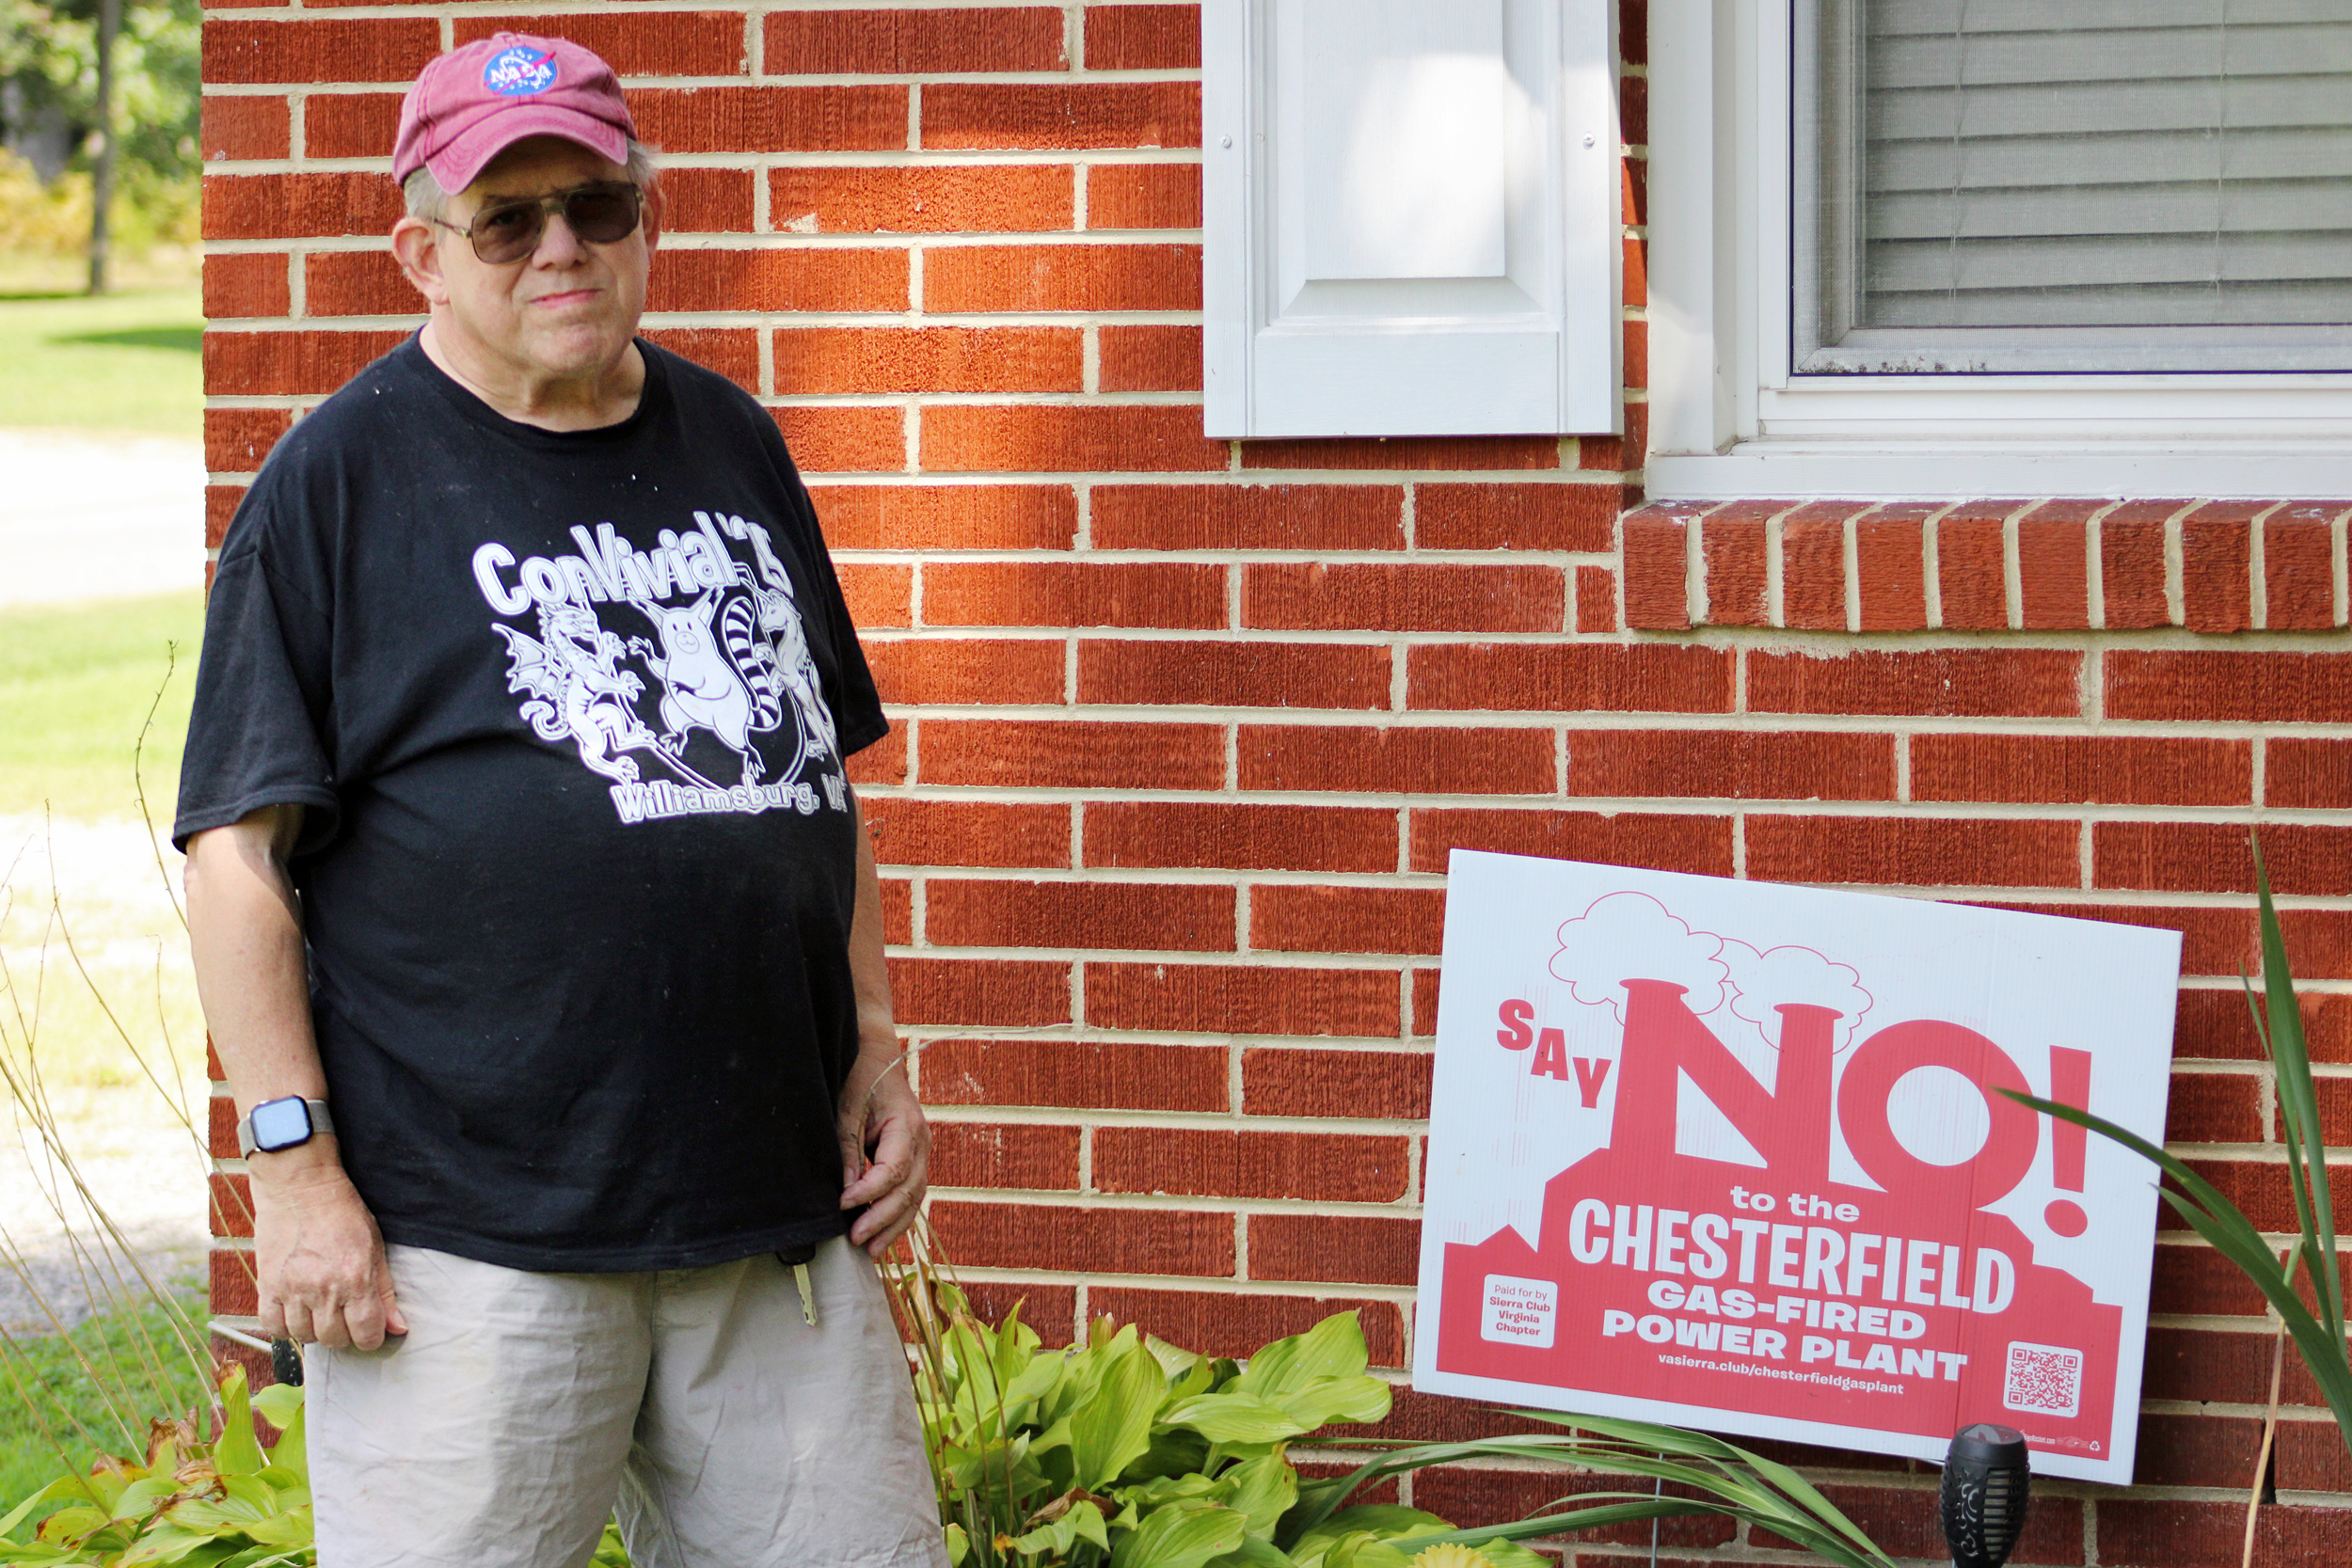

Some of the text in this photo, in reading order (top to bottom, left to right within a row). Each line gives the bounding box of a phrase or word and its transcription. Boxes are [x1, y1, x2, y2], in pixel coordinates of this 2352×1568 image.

[490, 63, 553, 83] NASA
[473, 511, 740, 615] ConVivial
[611, 771, 848, 824] Williamsburg, VA
[1497, 999, 1613, 1109] SAY
[1610, 978, 2092, 1238] NO!
[1730, 1185, 1860, 1222] to the
[1568, 1198, 2016, 1314] CHESTERFIELD
[1489, 1296, 1551, 1312] Sierra Club
[1494, 1284, 1548, 1302] Paid for by
[1499, 1309, 1540, 1323] Virginia
[1647, 1279, 1927, 1340] GAS-FIRED
[1496, 1322, 1541, 1336] Chapter
[1602, 1309, 1968, 1383] POWER PLANT
[1658, 1354, 1904, 1394] vasierra.club/chesterfieldgasplant
